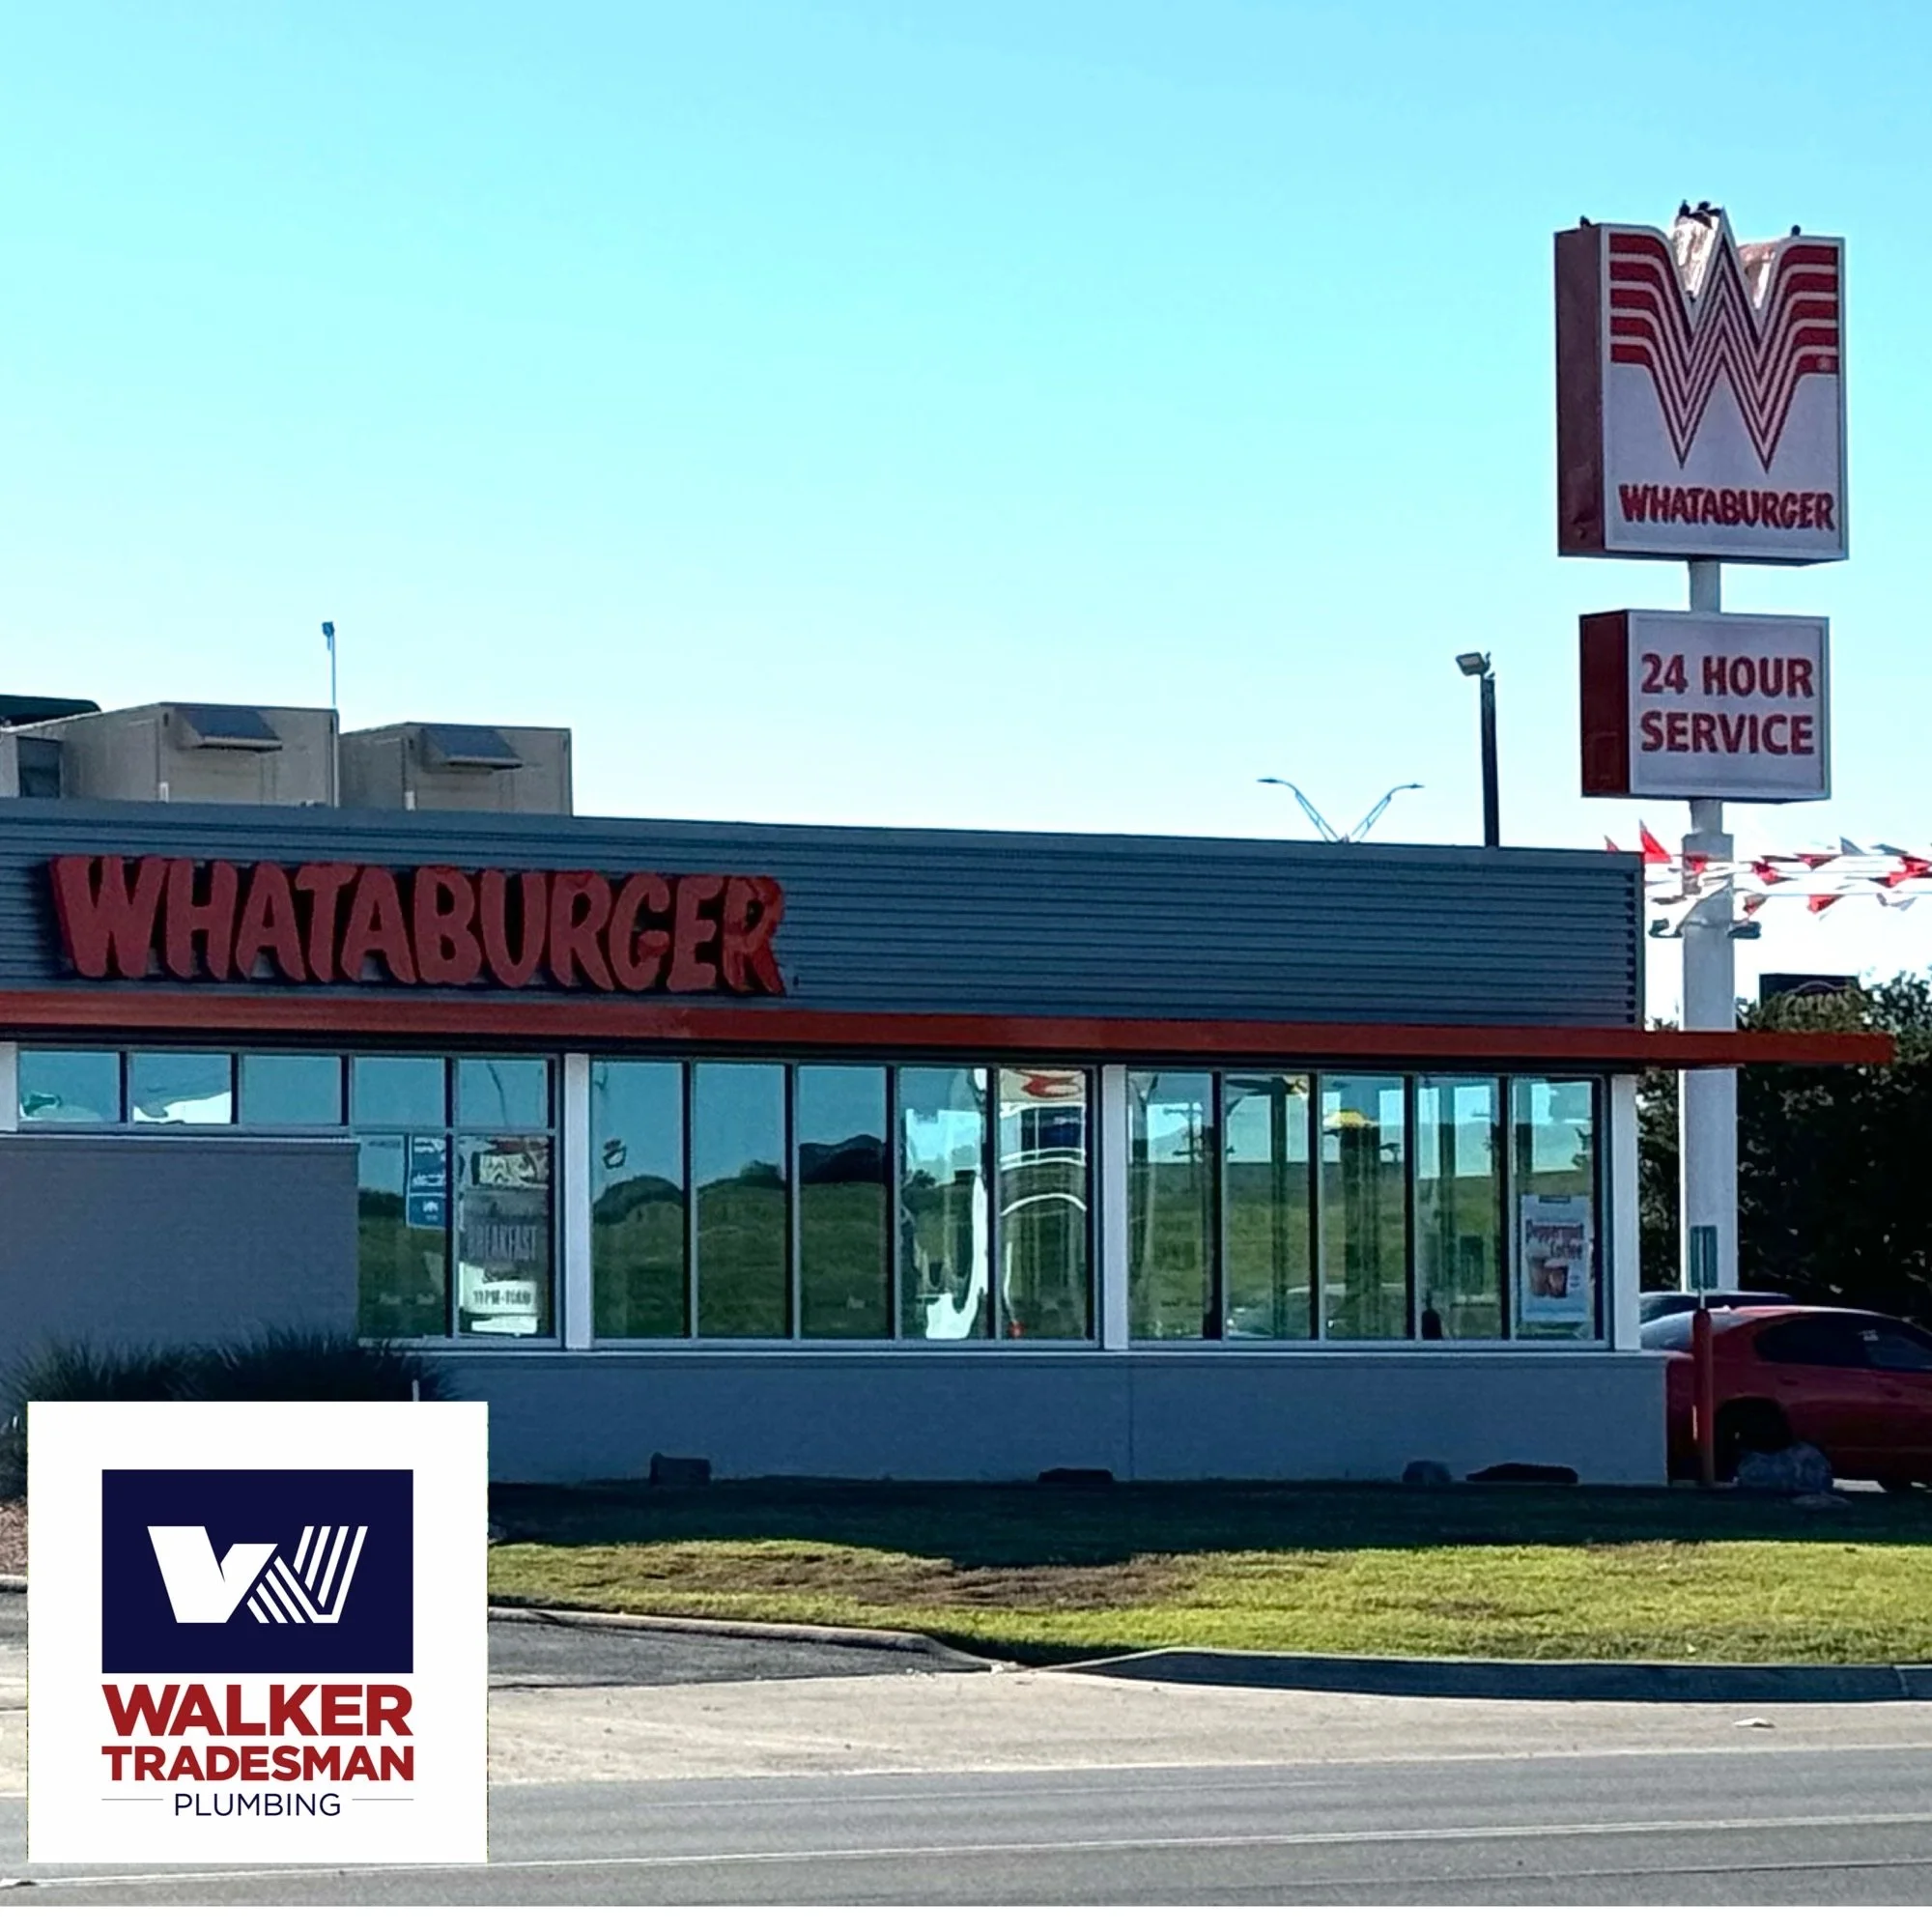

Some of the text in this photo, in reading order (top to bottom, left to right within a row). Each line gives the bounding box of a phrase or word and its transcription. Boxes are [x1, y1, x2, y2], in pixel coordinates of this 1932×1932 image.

[1619, 484, 1834, 531] WHATABURGER
[1640, 653, 1815, 697] 24 HOUR
[1640, 711, 1815, 755] SERVICE
[49, 855, 786, 995] WHATABURGER
